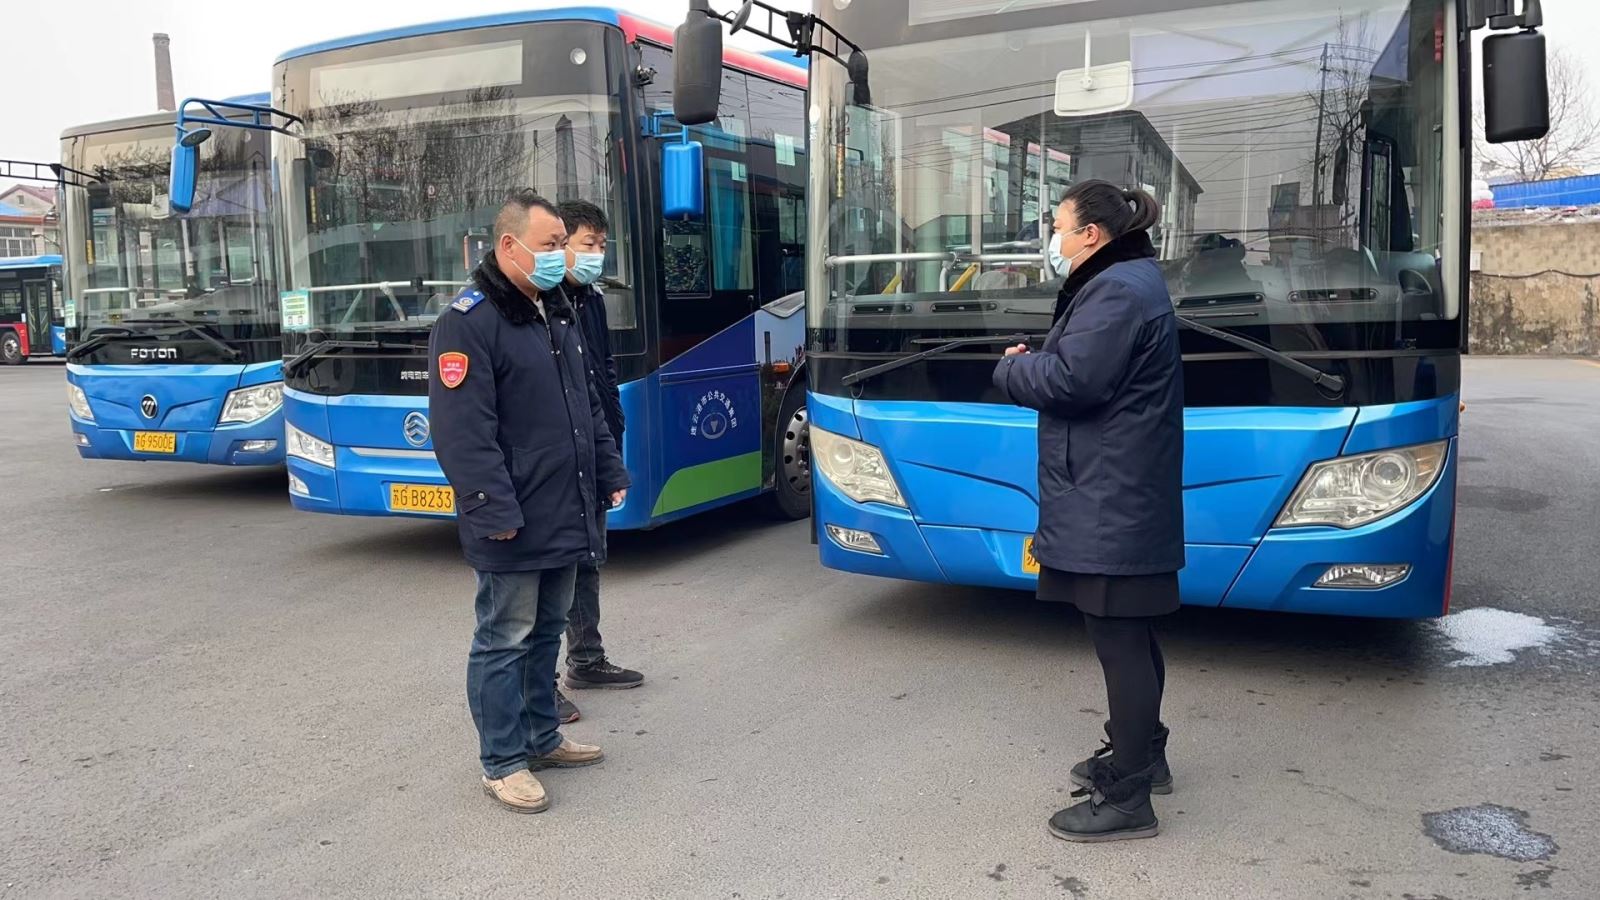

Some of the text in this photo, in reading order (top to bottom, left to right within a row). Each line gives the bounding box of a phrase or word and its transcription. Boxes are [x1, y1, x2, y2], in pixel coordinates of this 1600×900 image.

[131, 348, 177, 359] FOTON
[691, 390, 737, 436] 连云港市公共交通集团
